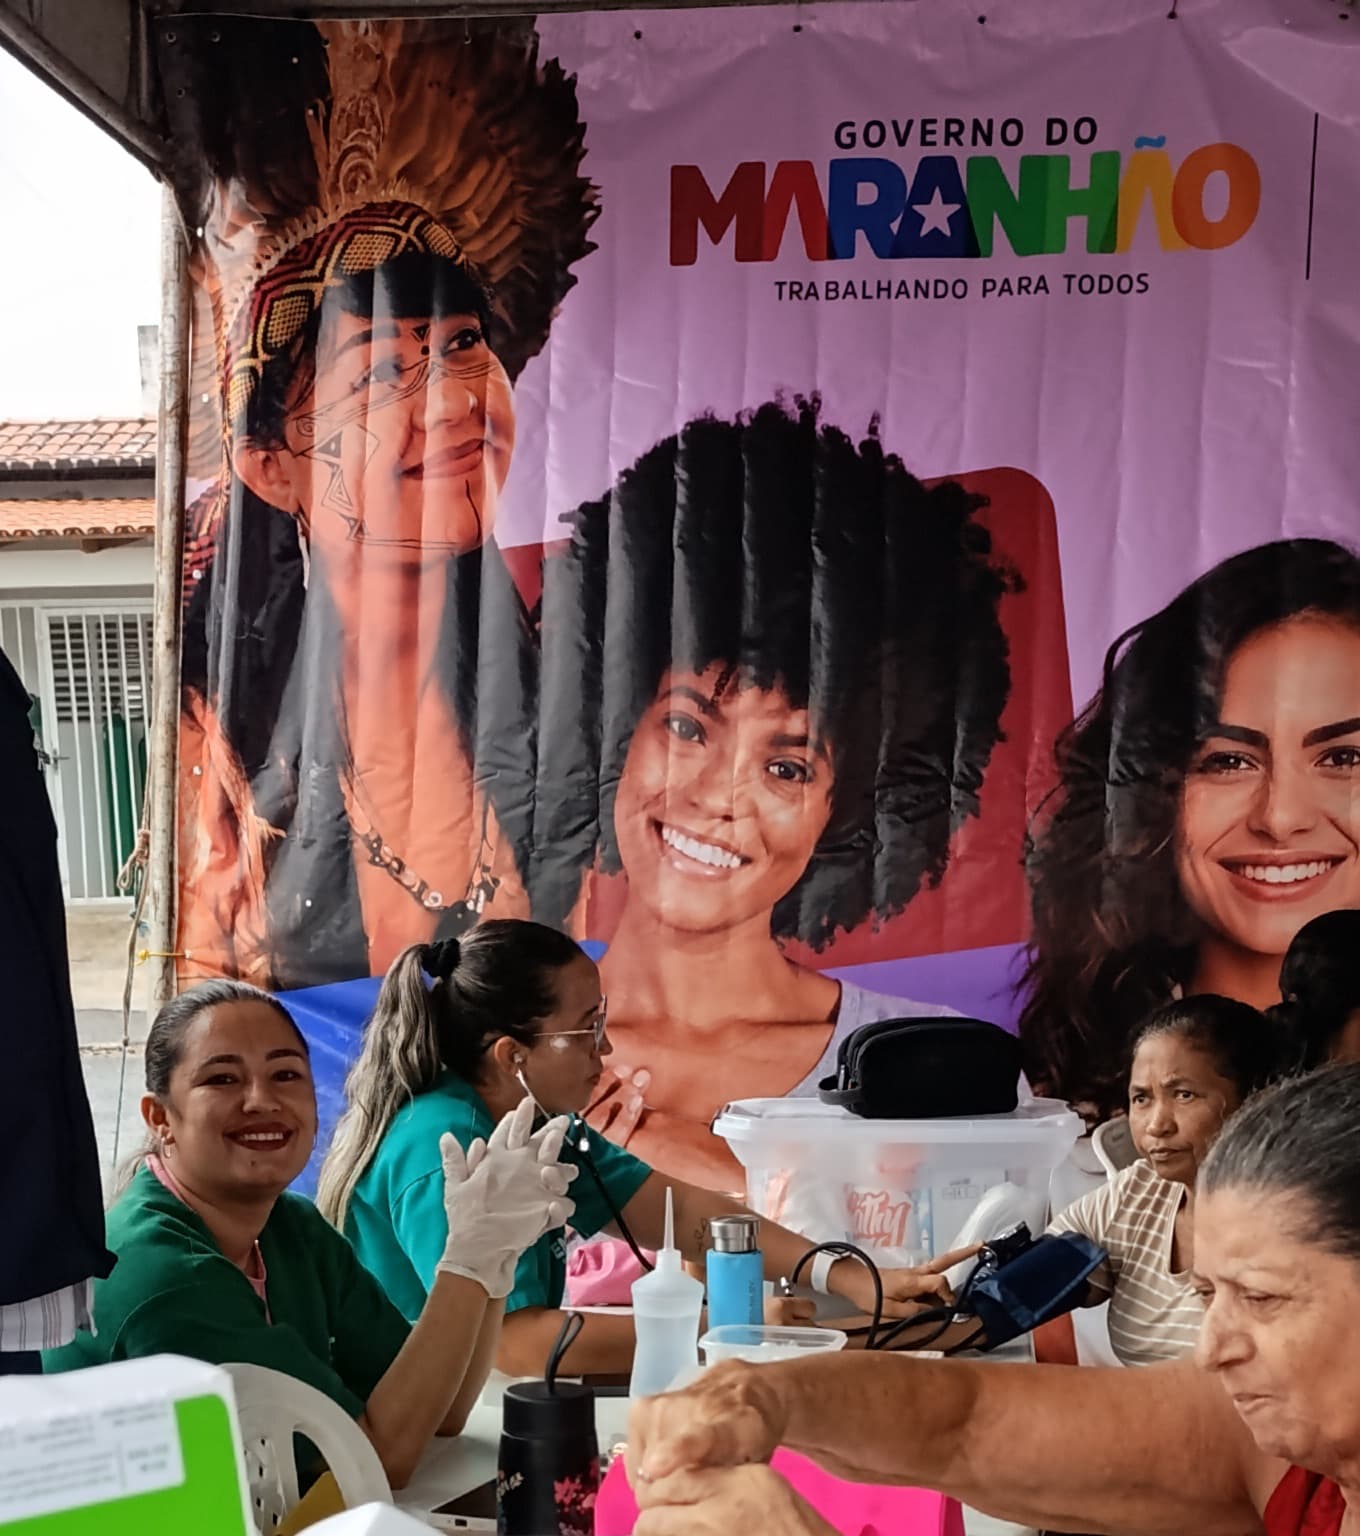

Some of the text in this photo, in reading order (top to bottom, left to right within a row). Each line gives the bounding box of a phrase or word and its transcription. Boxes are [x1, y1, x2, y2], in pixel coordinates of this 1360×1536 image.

[833, 116, 1099, 150] GOVERNO DO
[668, 133, 1263, 267] MARANHÃO
[773, 272, 1151, 303] TRABALHANDO PARA TODOS
